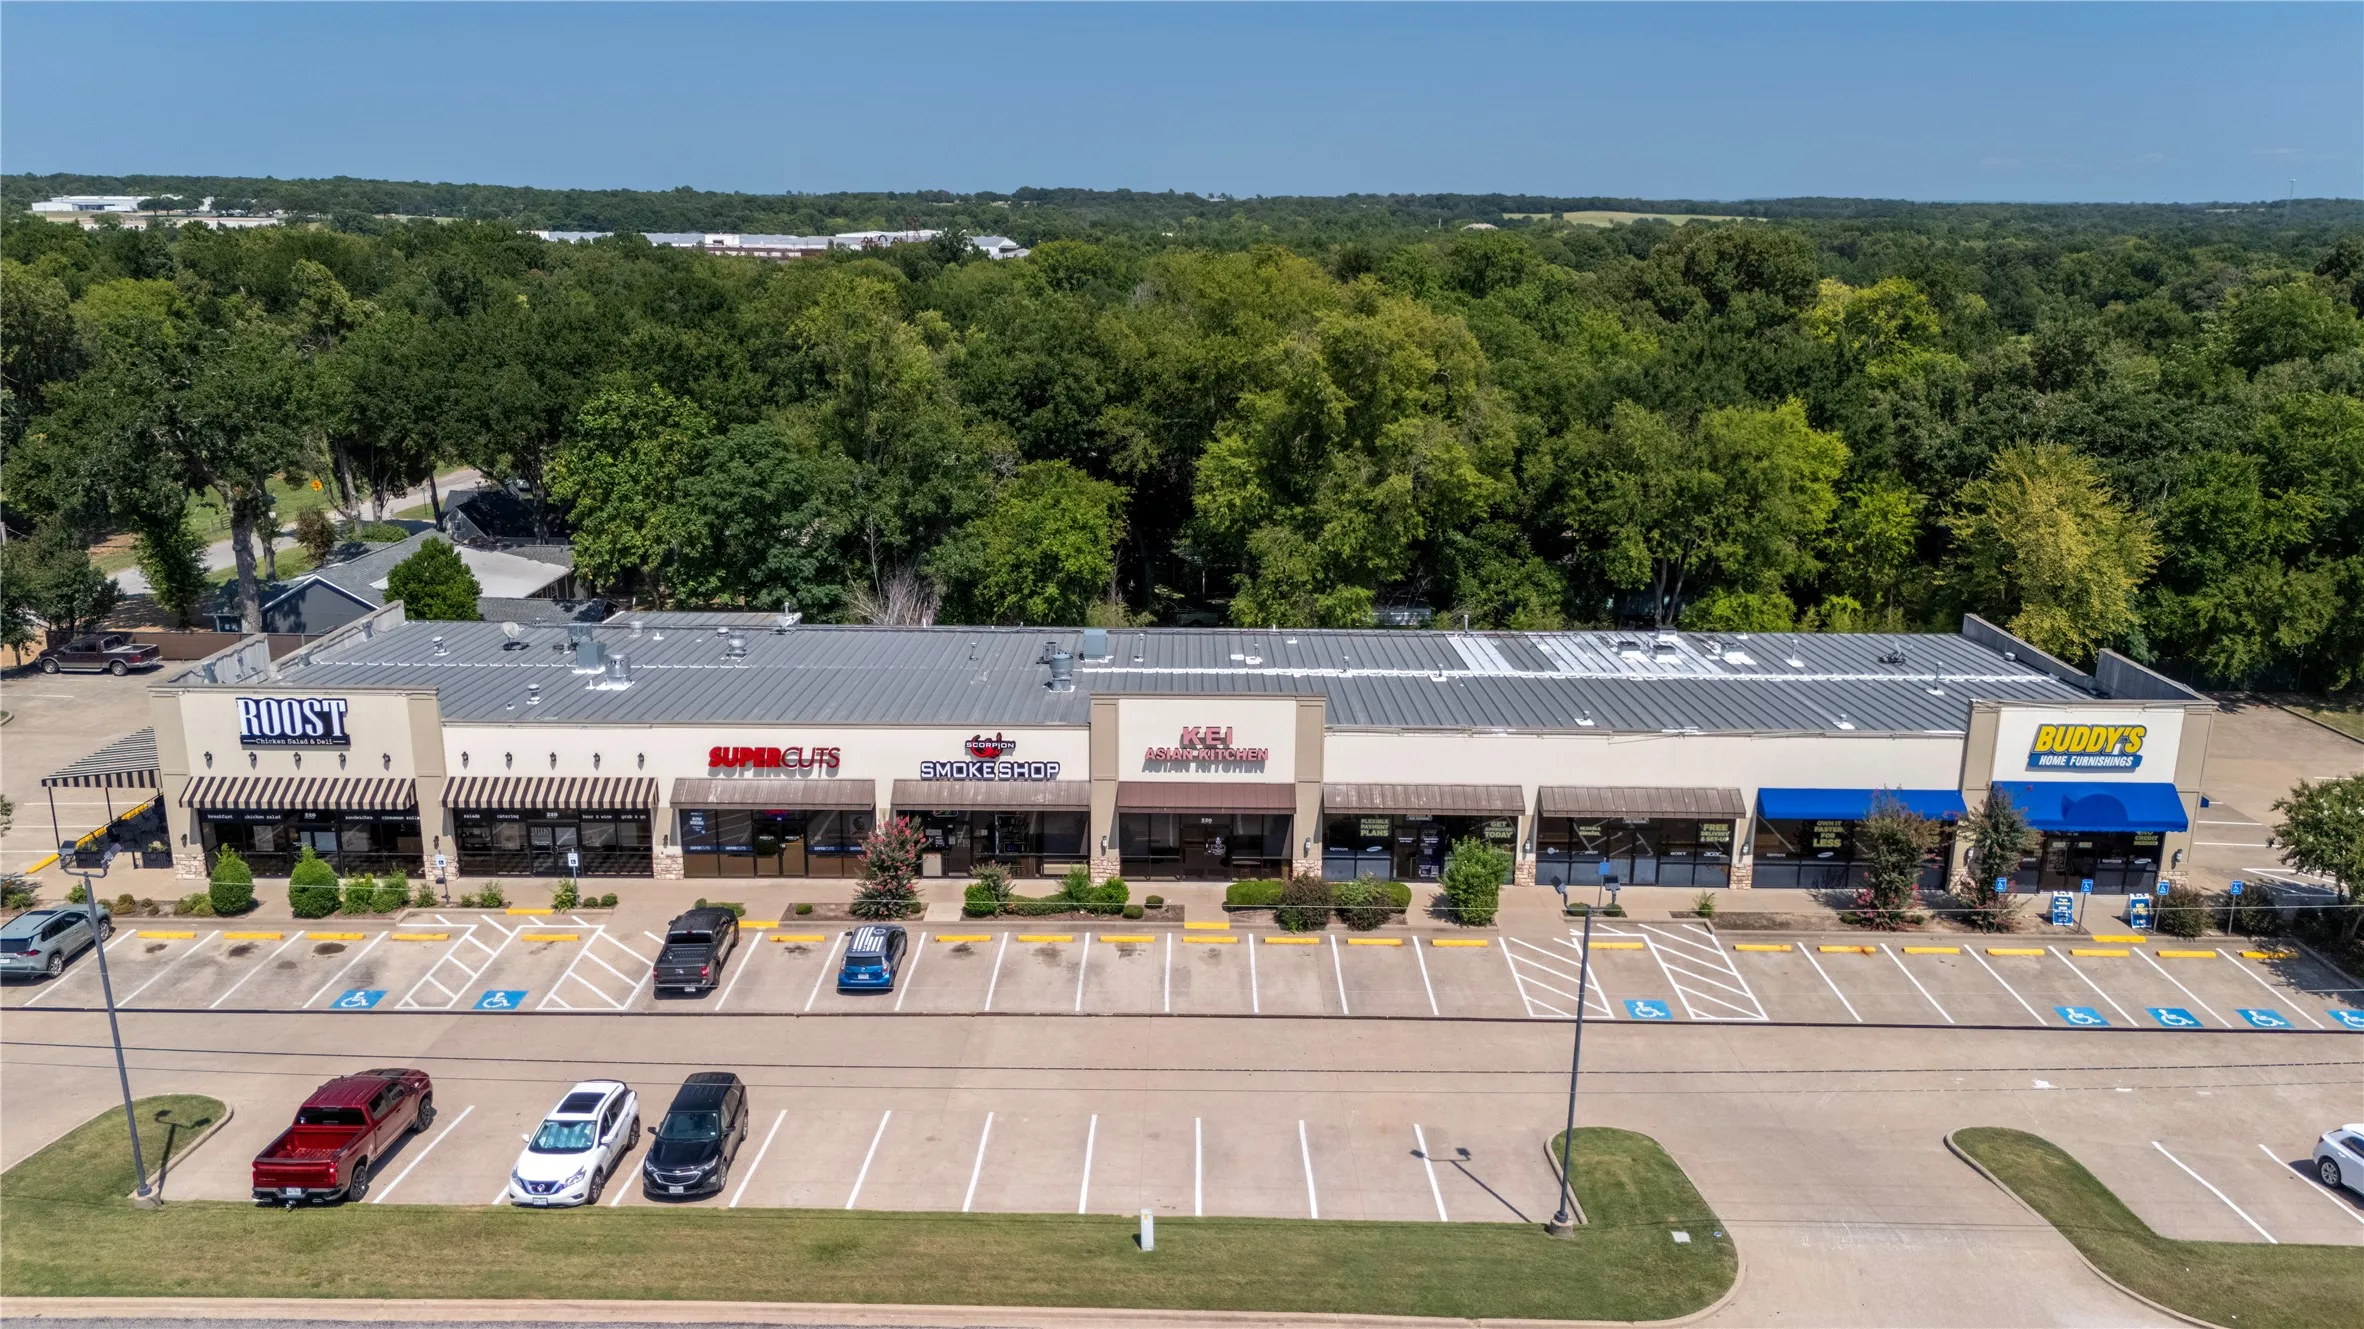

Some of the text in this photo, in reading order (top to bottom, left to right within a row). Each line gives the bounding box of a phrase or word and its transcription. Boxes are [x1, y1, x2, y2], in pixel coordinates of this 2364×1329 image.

[237, 699, 346, 736] ROOST
[1182, 726, 1233, 745] KEI
[2034, 725, 2145, 753] BUDDY'S
[708, 746, 840, 768] SUPERCUTS
[1145, 747, 1268, 760] ASIAN KITCHEN
[2039, 755, 2133, 766] HOME FURNISHINGS
[921, 762, 1059, 779] SMOKE SHOP
[1484, 831, 1513, 839] TODAY
[1813, 838, 1842, 847] LESS
